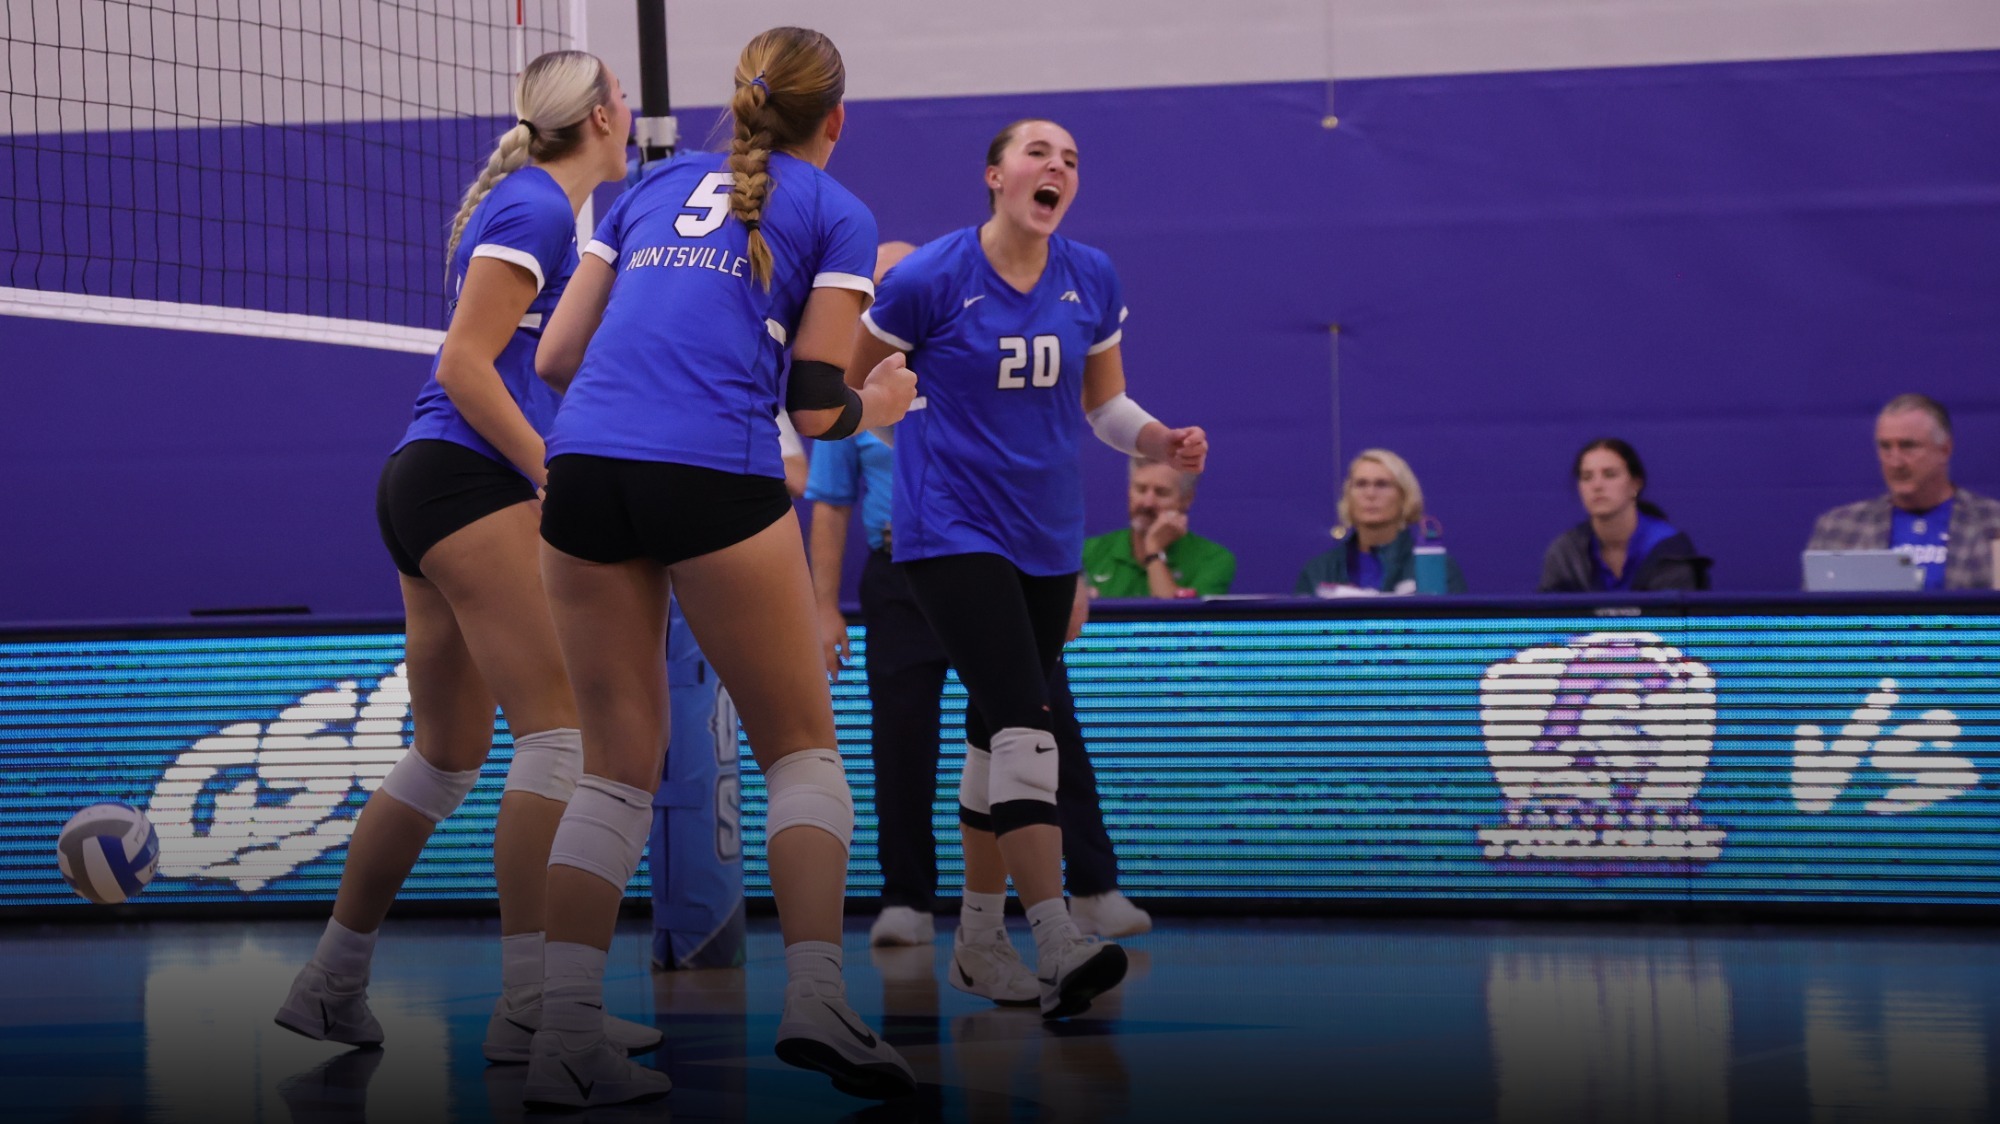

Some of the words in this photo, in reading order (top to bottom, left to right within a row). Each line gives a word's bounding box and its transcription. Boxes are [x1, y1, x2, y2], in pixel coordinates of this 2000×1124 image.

[673, 171, 736, 238] 5
[625, 246, 748, 278] HUNTSVILLE
[997, 334, 1061, 389] 20
[1790, 678, 1982, 815] VS
